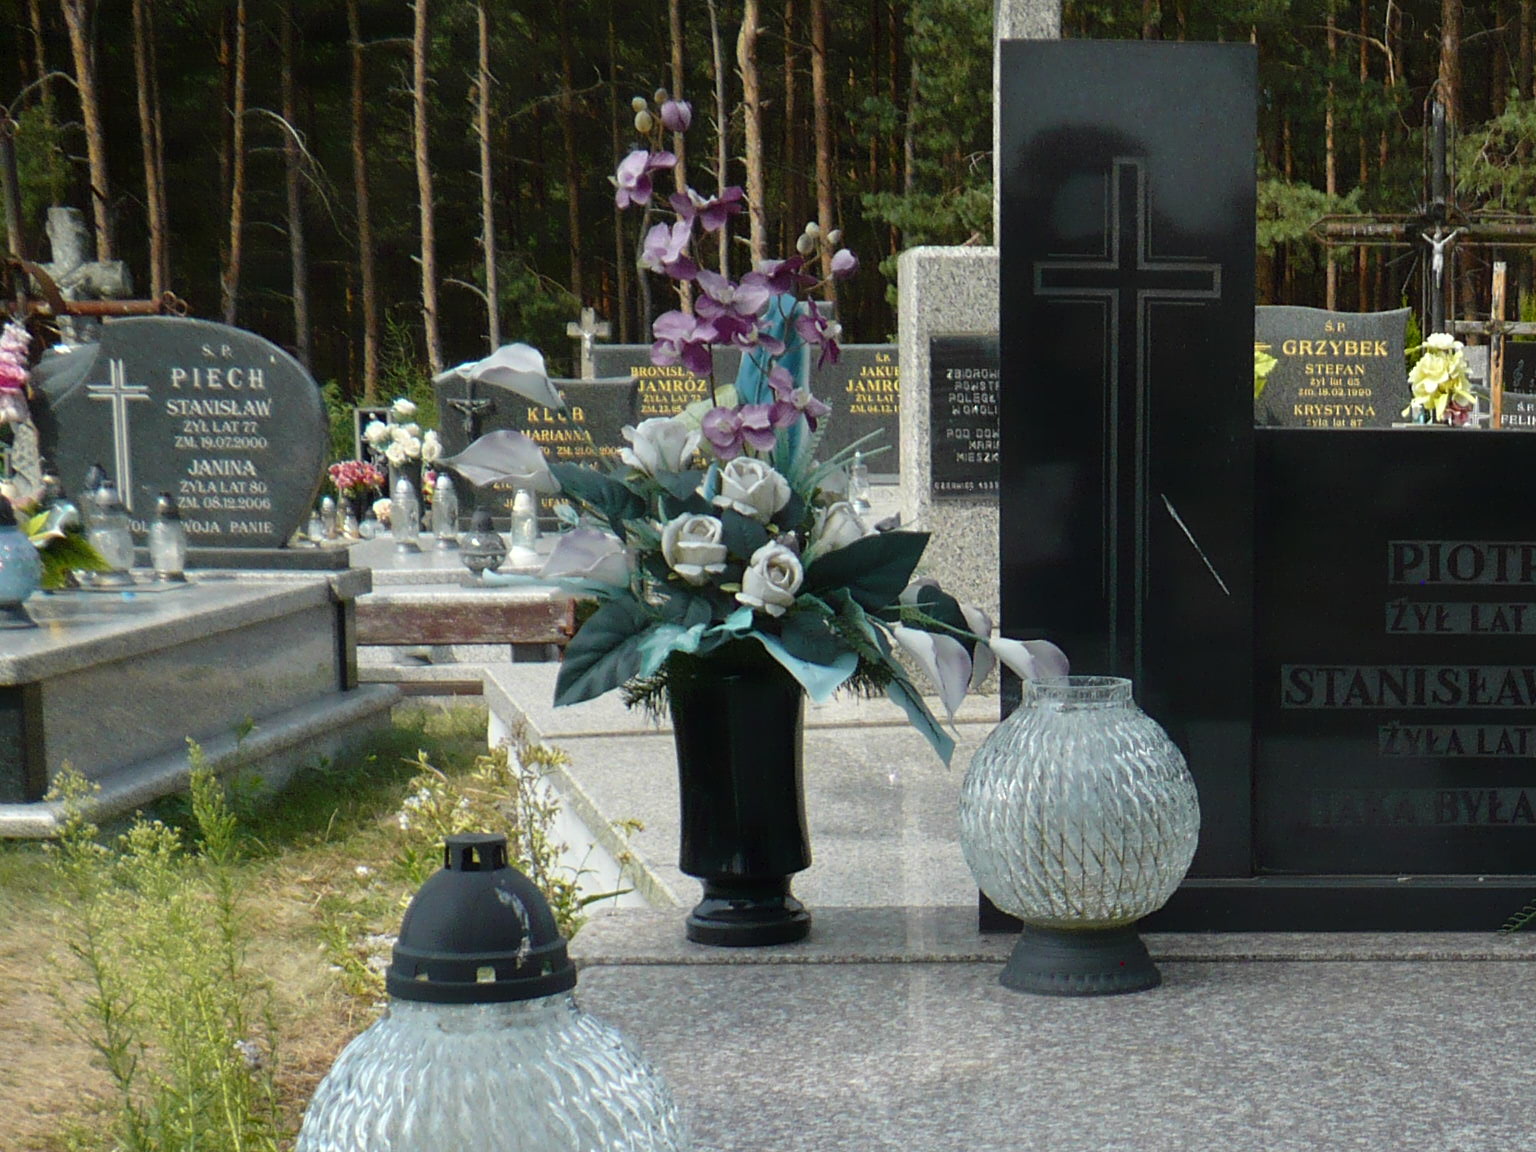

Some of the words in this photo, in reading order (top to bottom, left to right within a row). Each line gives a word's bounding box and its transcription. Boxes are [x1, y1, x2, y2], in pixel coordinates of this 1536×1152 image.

[1282, 340, 1389, 356] GRZYBEK
[1305, 363, 1365, 376] STEFAN
[171, 367, 267, 391] PIECH
[637, 376, 708, 392] JAMRÓZ
[166, 399, 273, 417] STANISŁAW
[1294, 404, 1376, 416] KRYSTYNA
[212, 421, 240, 434] LAT
[242, 421, 259, 434] 77
[201, 435, 268, 449] 19.07.2000
[955, 452, 1000, 463] MIESZK
[187, 459, 258, 477] JANINA
[220, 481, 247, 494] LAT
[249, 481, 268, 495] 80
[229, 520, 273, 535] PANIE
[1389, 597, 1453, 633] ŻYŁ
[1470, 603, 1528, 633] LAT
[1476, 727, 1532, 755] LAT
[1433, 788, 1536, 825] BYŁA
